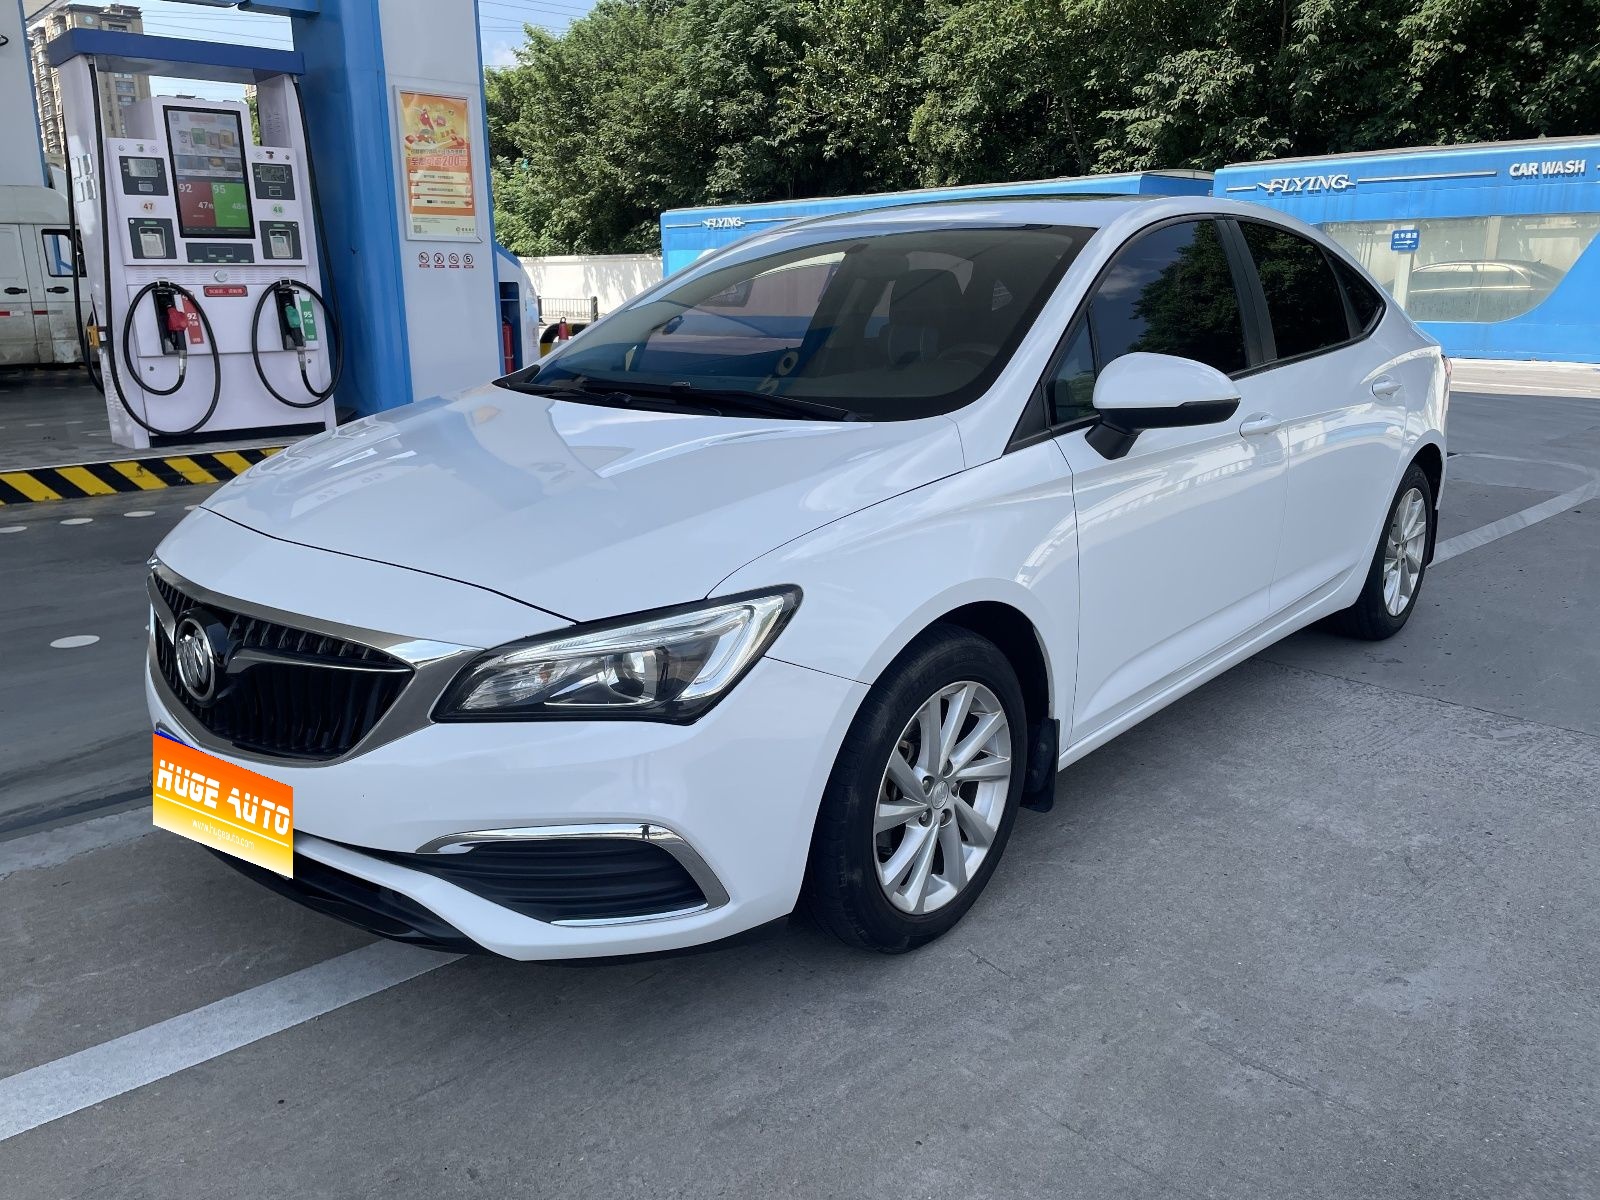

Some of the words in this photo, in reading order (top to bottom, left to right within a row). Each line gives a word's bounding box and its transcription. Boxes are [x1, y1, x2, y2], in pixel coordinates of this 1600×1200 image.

[1509, 162, 1539, 177] CAR
[1541, 160, 1586, 174] WASH
[178, 183, 193, 193] 92
[212, 184, 226, 194] 95
[1259, 174, 1354, 194] FLYING
[143, 202, 154, 210] 47
[704, 216, 744, 228] FLYING
[187, 312, 198, 320] 92
[303, 311, 313, 319] 95
